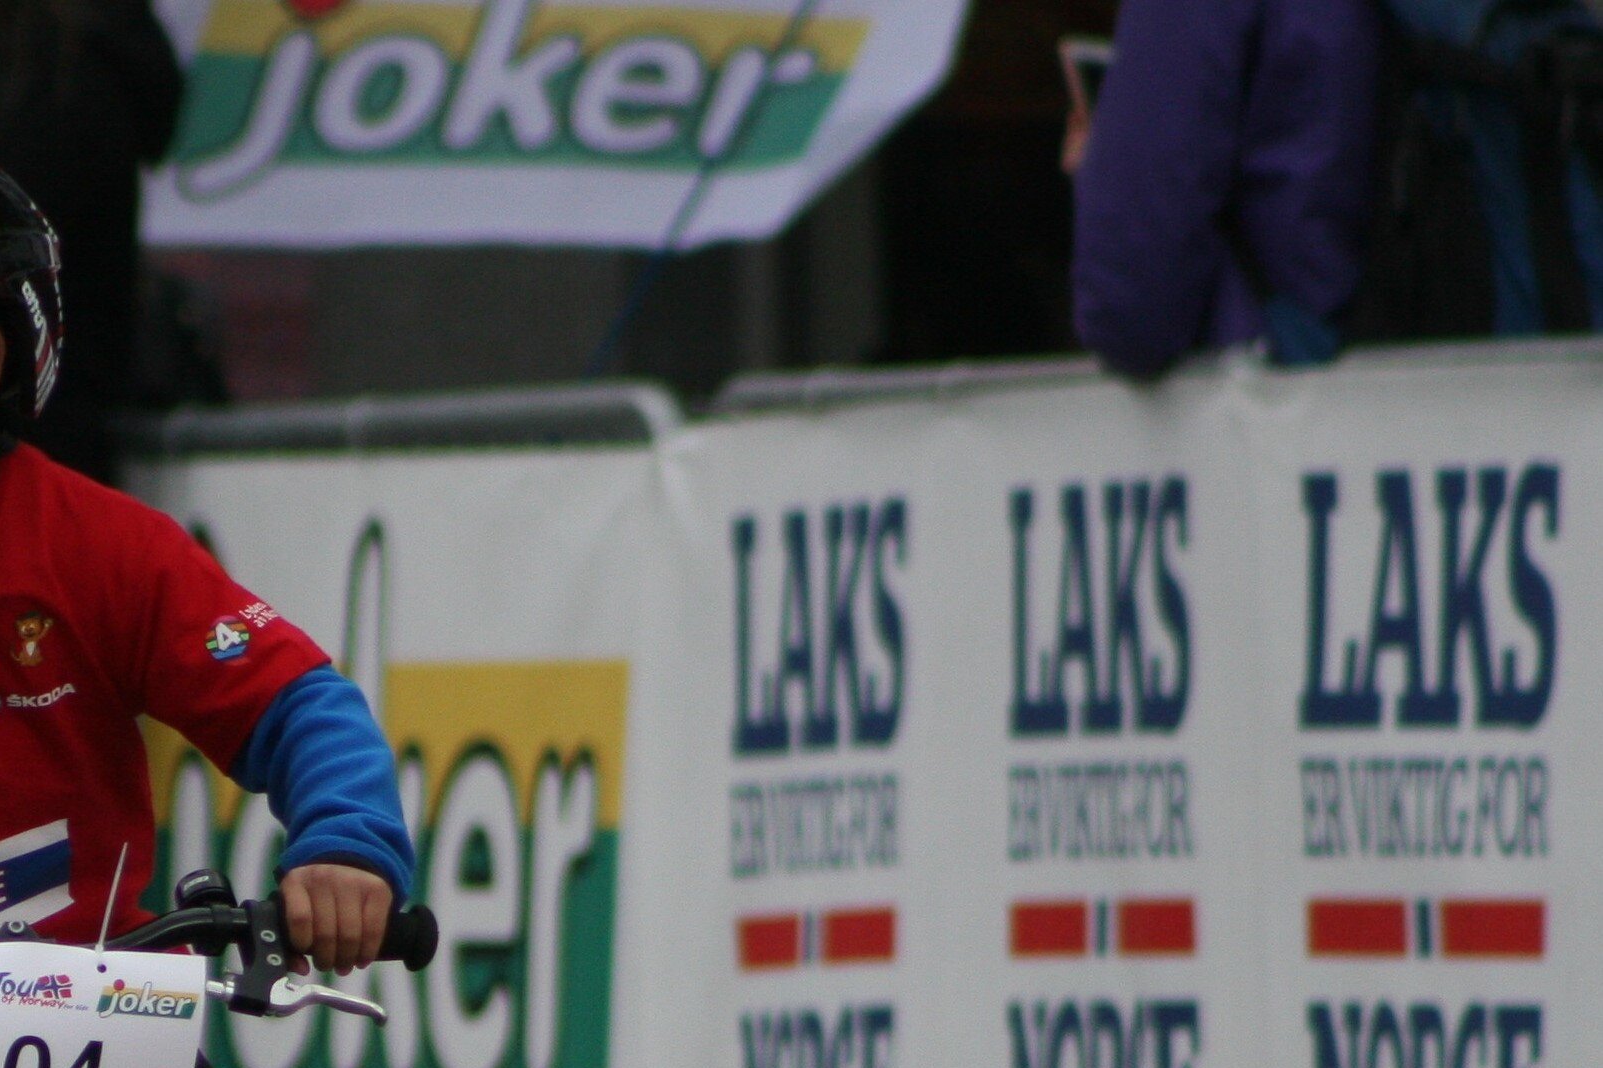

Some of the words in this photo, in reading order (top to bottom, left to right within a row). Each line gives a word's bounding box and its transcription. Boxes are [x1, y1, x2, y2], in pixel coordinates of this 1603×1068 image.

[178, 0, 818, 203] joker
[6, 682, 76, 708] ŠKODA
[731, 495, 909, 758] LAKS
[1009, 475, 1191, 738] LAKS
[1299, 463, 1561, 731] LAKS
[1301, 757, 1346, 857] ER
[1348, 756, 1469, 857] VIKTIG
[1472, 755, 1551, 857] FOR
[100, 978, 195, 1019] joker
